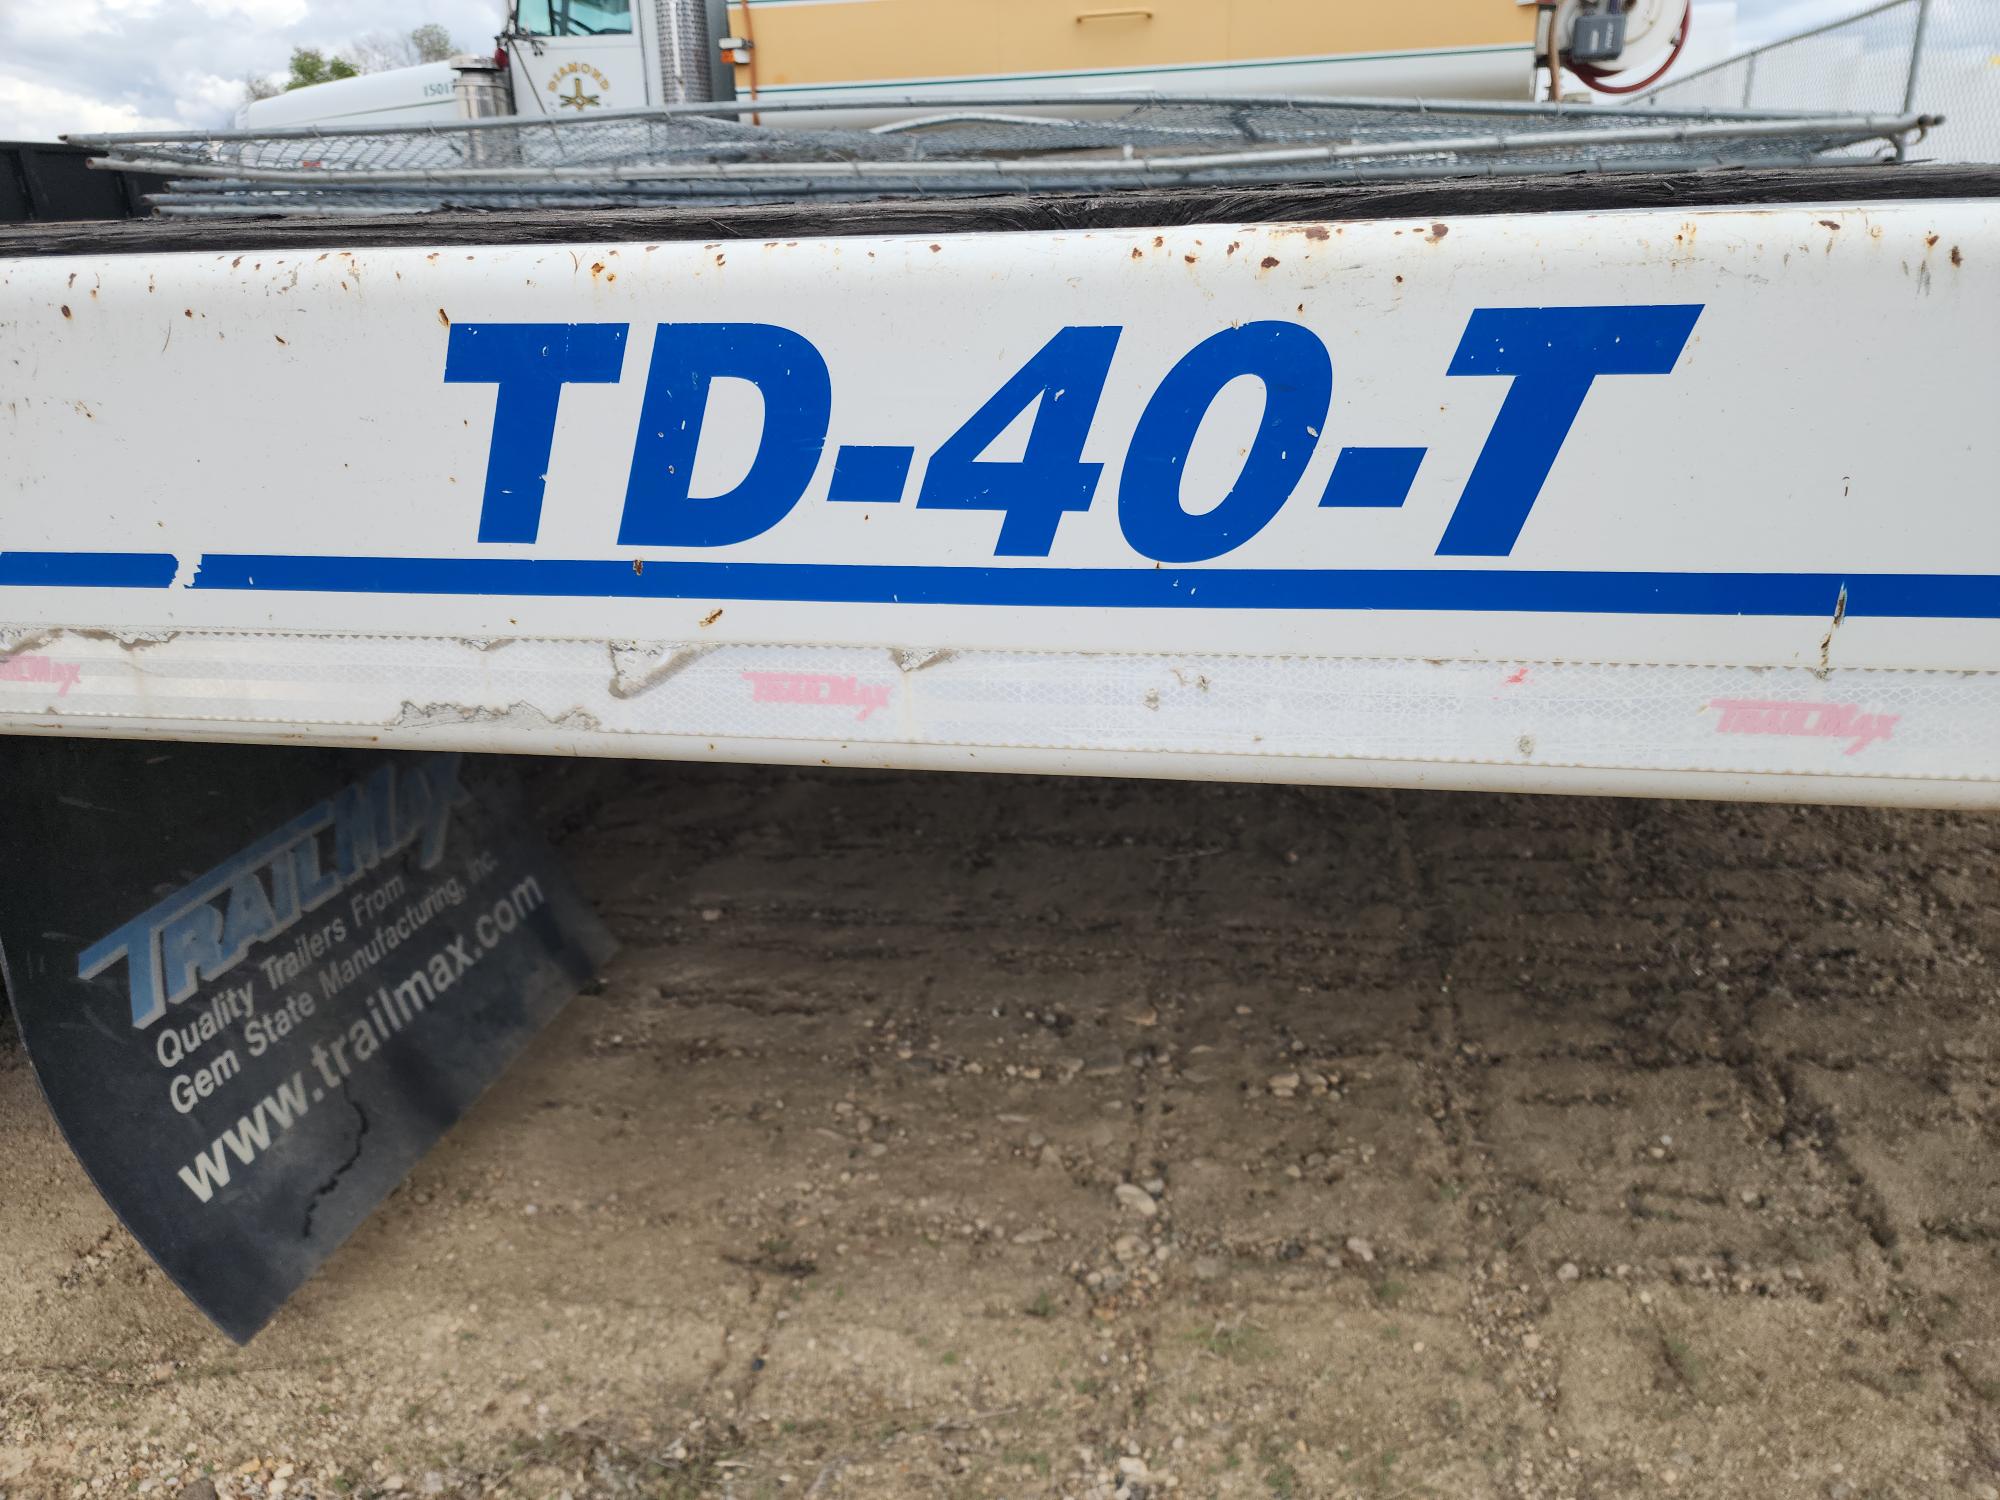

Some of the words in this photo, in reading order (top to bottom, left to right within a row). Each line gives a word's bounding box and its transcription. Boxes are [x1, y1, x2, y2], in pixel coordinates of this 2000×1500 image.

[547, 63, 609, 92] DIAMOND
[444, 303, 1706, 564] TD-40-T
[157, 980, 254, 1068] Quality
[260, 917, 347, 990] Trailers
[350, 874, 406, 927] From
[170, 1050, 241, 1114] Gem
[244, 992, 316, 1057] State
[177, 875, 545, 1203] www.trailmax.com
